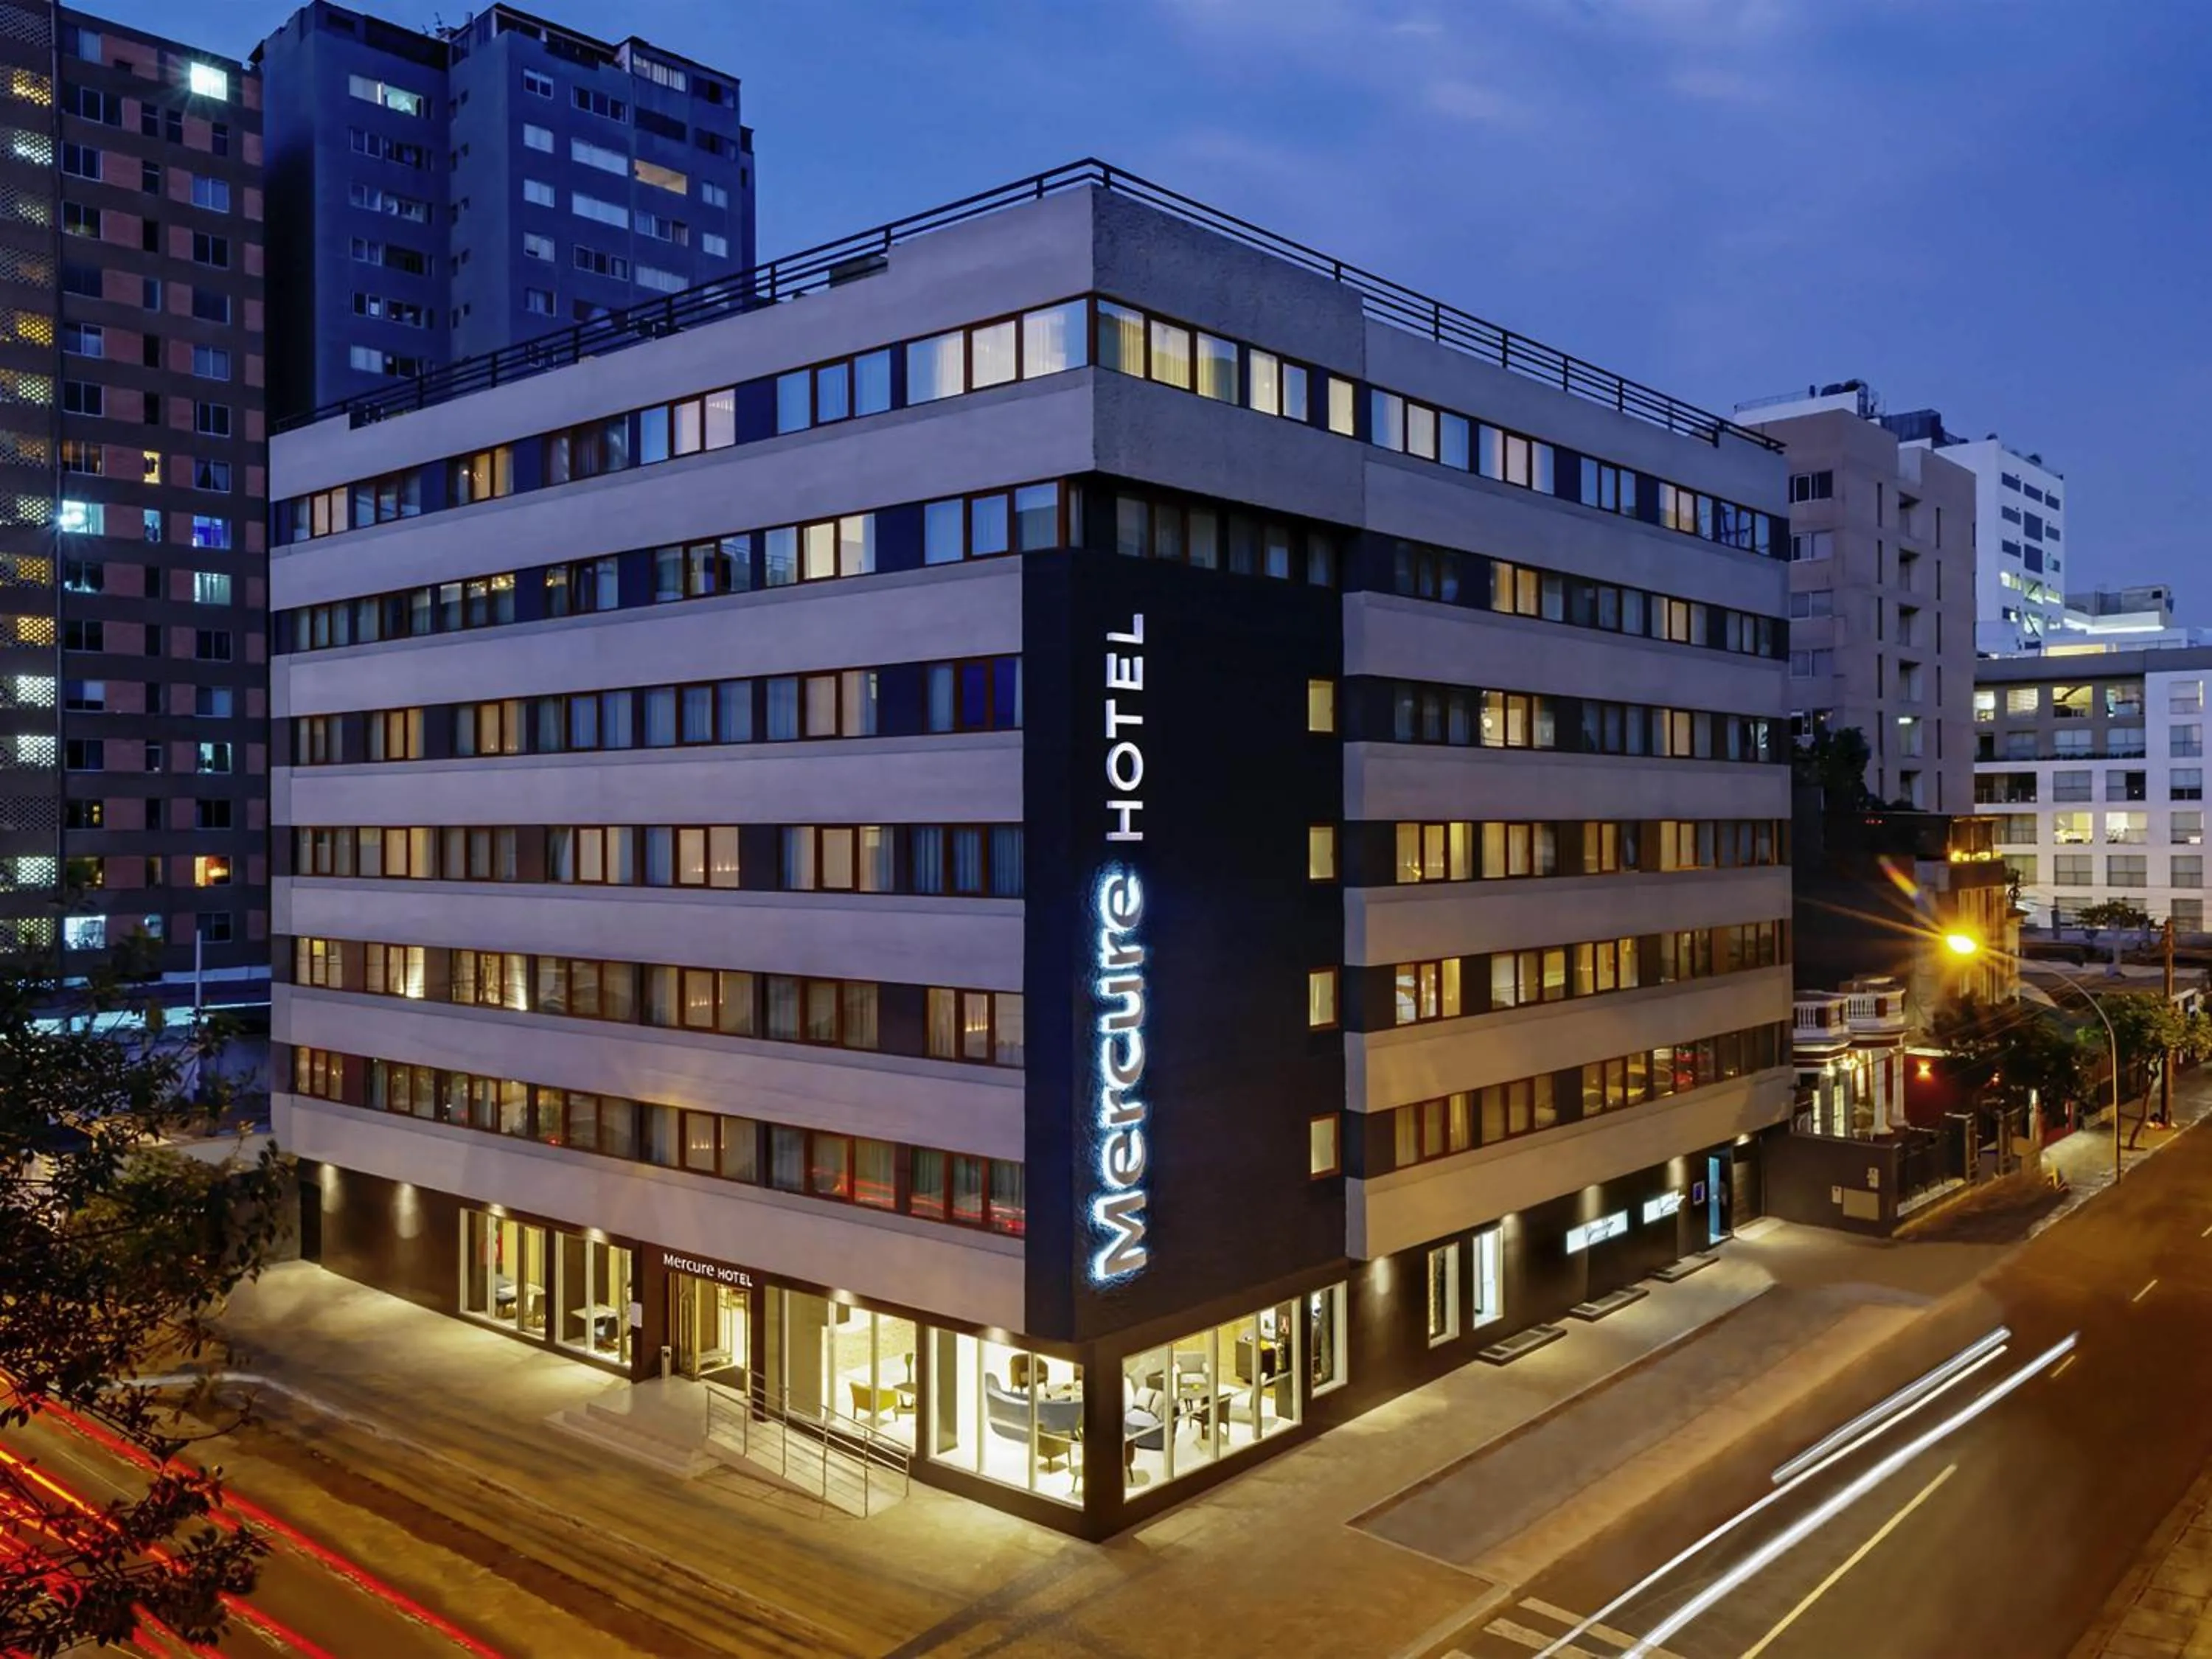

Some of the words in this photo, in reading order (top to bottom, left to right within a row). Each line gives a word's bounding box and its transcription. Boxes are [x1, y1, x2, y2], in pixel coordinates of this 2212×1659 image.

[1105, 613, 1144, 841] HOTEL
[1094, 874, 1147, 1278] Mercure
[664, 1253, 714, 1276] Mercure
[717, 1267, 753, 1287] HOTEL
